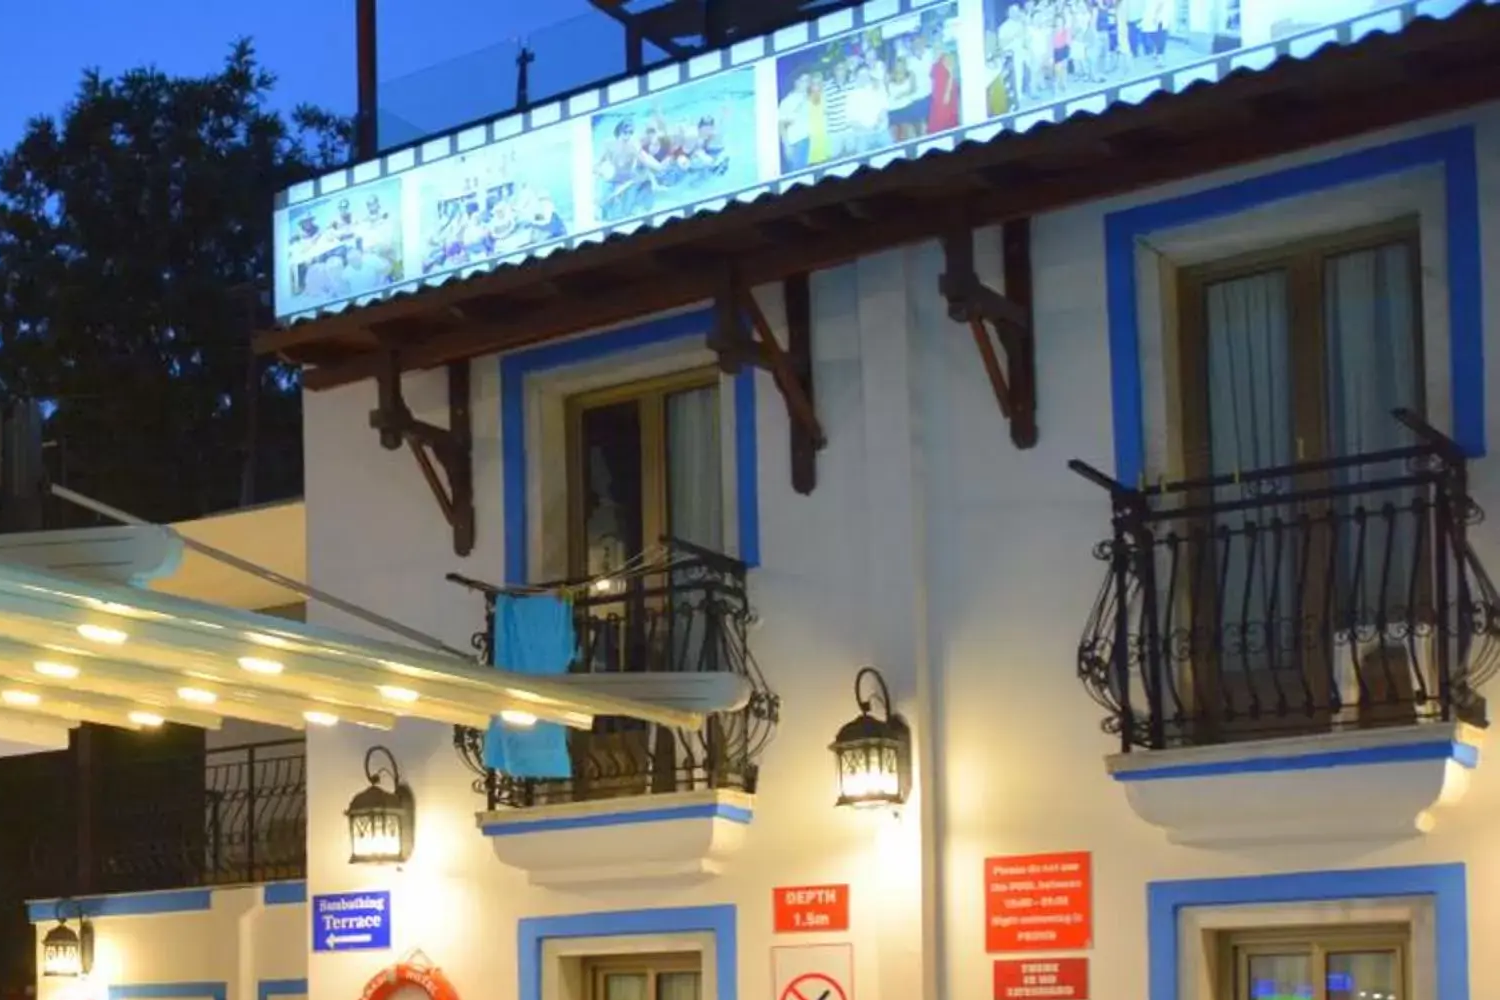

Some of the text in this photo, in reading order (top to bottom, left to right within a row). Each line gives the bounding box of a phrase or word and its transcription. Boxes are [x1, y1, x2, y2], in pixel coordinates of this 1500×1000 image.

[785, 889, 836, 905] DEPTH
[323, 915, 381, 930] Terrace
[793, 911, 830, 927] 1.5m
